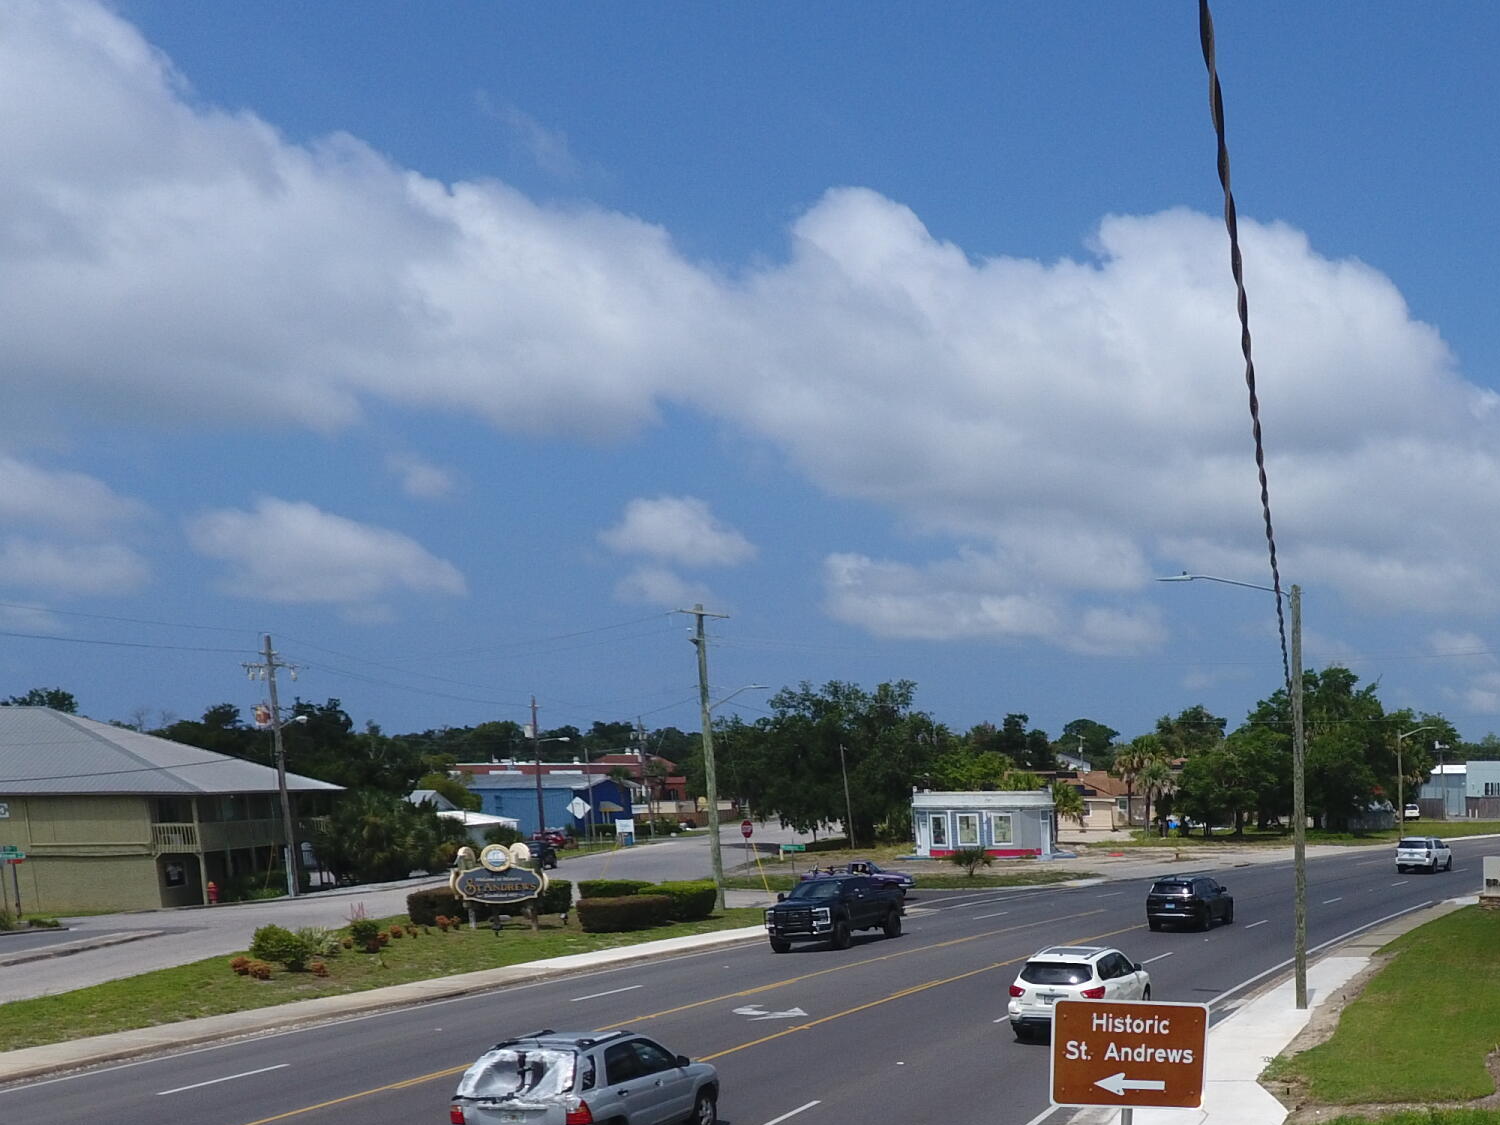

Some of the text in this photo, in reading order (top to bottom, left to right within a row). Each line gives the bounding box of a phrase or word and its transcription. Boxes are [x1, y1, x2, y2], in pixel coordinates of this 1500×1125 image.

[1092, 1012, 1170, 1034] Historic
[1065, 1040, 1194, 1064] St. Andrews
